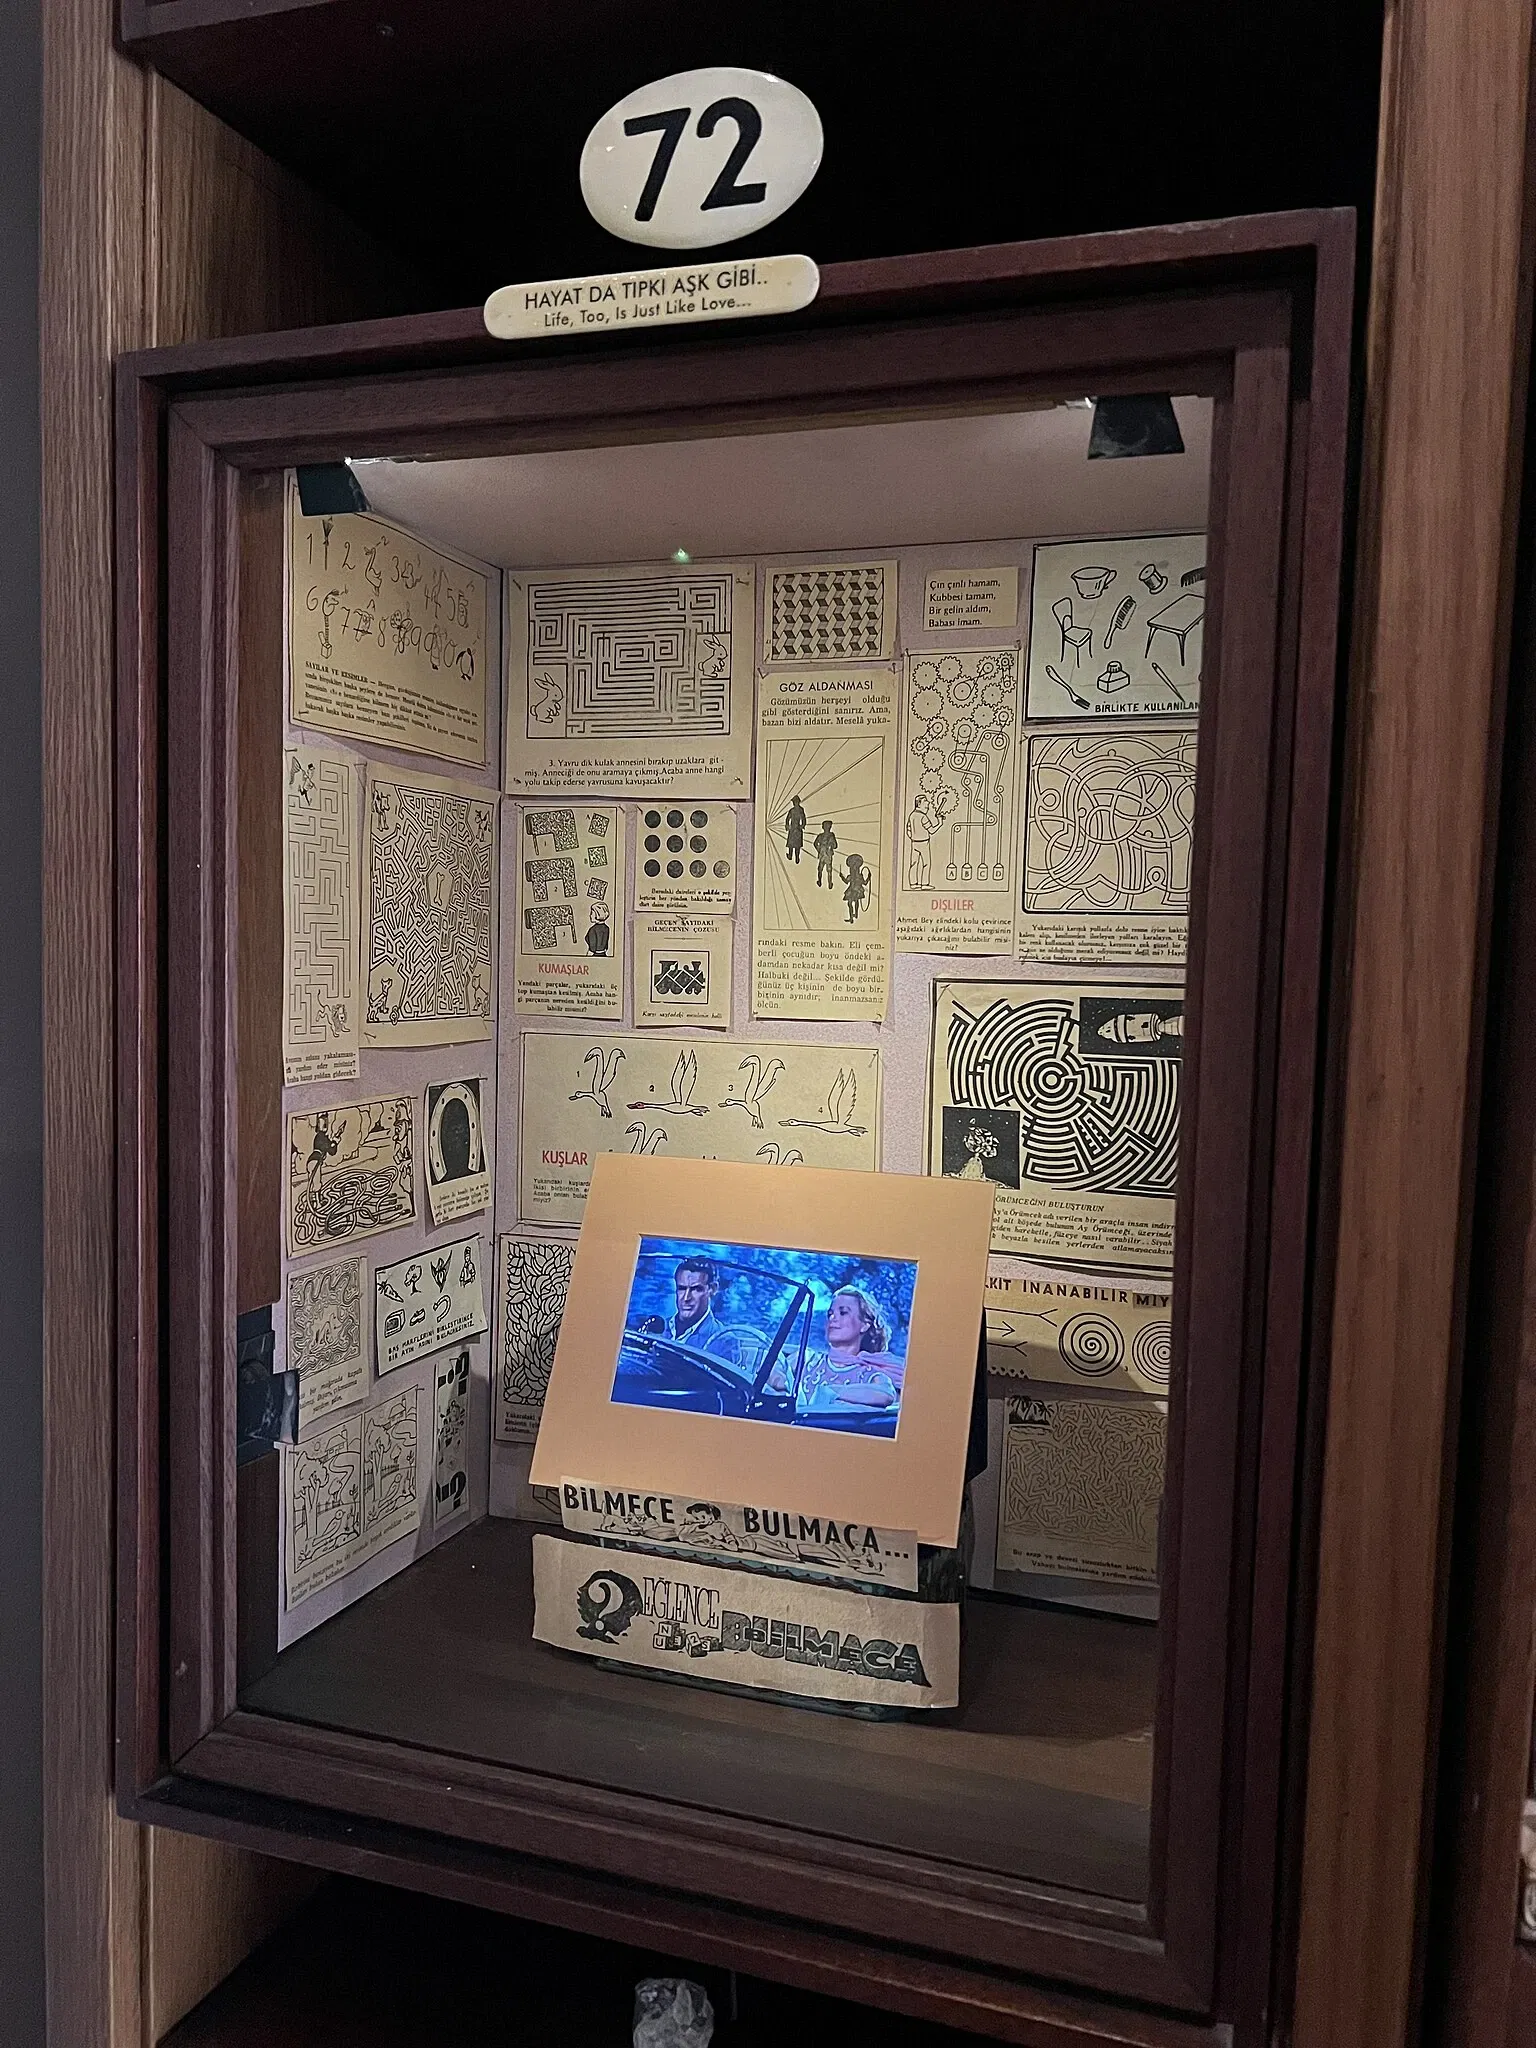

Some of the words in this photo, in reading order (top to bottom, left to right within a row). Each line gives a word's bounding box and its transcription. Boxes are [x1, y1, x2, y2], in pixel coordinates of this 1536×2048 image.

[623, 97, 767, 222] 72
[525, 287, 582, 310] HAYAT
[589, 285, 615, 303] DA
[622, 280, 665, 300] TIPKI
[673, 273, 710, 297] AŞK
[717, 267, 768, 289] GİBİ..
[544, 311, 573, 329] Life,
[580, 308, 609, 324] Too,
[616, 306, 626, 319] Is
[632, 303, 660, 318] Just
[666, 299, 695, 315] Like
[701, 296, 751, 312] Love...
[968, 579, 1000, 588] hamam,
[930, 593, 963, 602] Kubbesi
[966, 593, 996, 601] tamam,
[929, 606, 941, 614] Bir
[944, 605, 963, 616] gelin
[965, 605, 991, 613] aldım,
[929, 618, 955, 627] Babası
[779, 682, 804, 692] GÖZ
[809, 680, 873, 692] ALDANMASI
[771, 697, 816, 706] Gözümüzün
[862, 695, 891, 704] olduğu
[762, 708, 777, 717] gibi
[782, 706, 829, 717] gösterdiğini
[834, 707, 864, 715] sanırız.
[868, 706, 891, 714] Ama,
[1095, 701, 1140, 713] BİRLİKTE
[762, 719, 784, 727] bazan
[788, 718, 801, 726] bizi
[867, 716, 891, 725] yuka-
[558, 759, 579, 767] Yavru
[594, 758, 614, 767] kulak
[616, 758, 646, 766] annesini
[647, 757, 673, 767] bırakıp
[675, 756, 705, 764] uzaklara
[542, 768, 574, 777] Anneciği
[576, 768, 585, 776] de
[603, 769, 632, 777] aramaya
[704, 765, 725, 775] hangi
[543, 778, 561, 786] takip
[563, 778, 585, 786] ederse
[588, 779, 623, 787] yavrusuna
[931, 898, 974, 912] DİŞLİLER
[758, 939, 787, 947] rındaki
[820, 940, 845, 948] bakın.
[849, 941, 861, 949] Eli
[865, 943, 885, 951] çem-
[758, 949, 777, 957] berli
[782, 950, 815, 959] çocuğun
[820, 952, 839, 960] boyu
[844, 952, 872, 960] öndeki
[538, 963, 589, 976] KUMAŞLAR
[757, 960, 789, 969] damdan
[792, 961, 824, 970] nekadar
[827, 962, 843, 970] kısa
[847, 963, 867, 972] değil
[758, 971, 789, 980] Halbuki
[824, 973, 855, 982] Şekilde
[858, 975, 884, 984] gördü-
[757, 981, 782, 989] ğünüz
[785, 982, 794, 991] üç
[798, 983, 825, 992] kişinin
[832, 984, 843, 992] de
[846, 985, 866, 993] boyu
[869, 985, 884, 993] bir-
[542, 1150, 588, 1167] KUŞLAR
[995, 1196, 1046, 1207] ÖRÜMCEĞİNİ
[1048, 1201, 1105, 1212] BULUŞTURUN
[1077, 1225, 1088, 1233] Ay
[1099, 1219, 1125, 1227] araçla
[1151, 1239, 1172, 1247] Siyah
[1023, 1280, 1128, 1304] İNANABİLİR
[563, 1483, 675, 1525] BİLMECE
[642, 1576, 720, 1629] EĞLENCE
[721, 1610, 932, 1688] BULMACA
